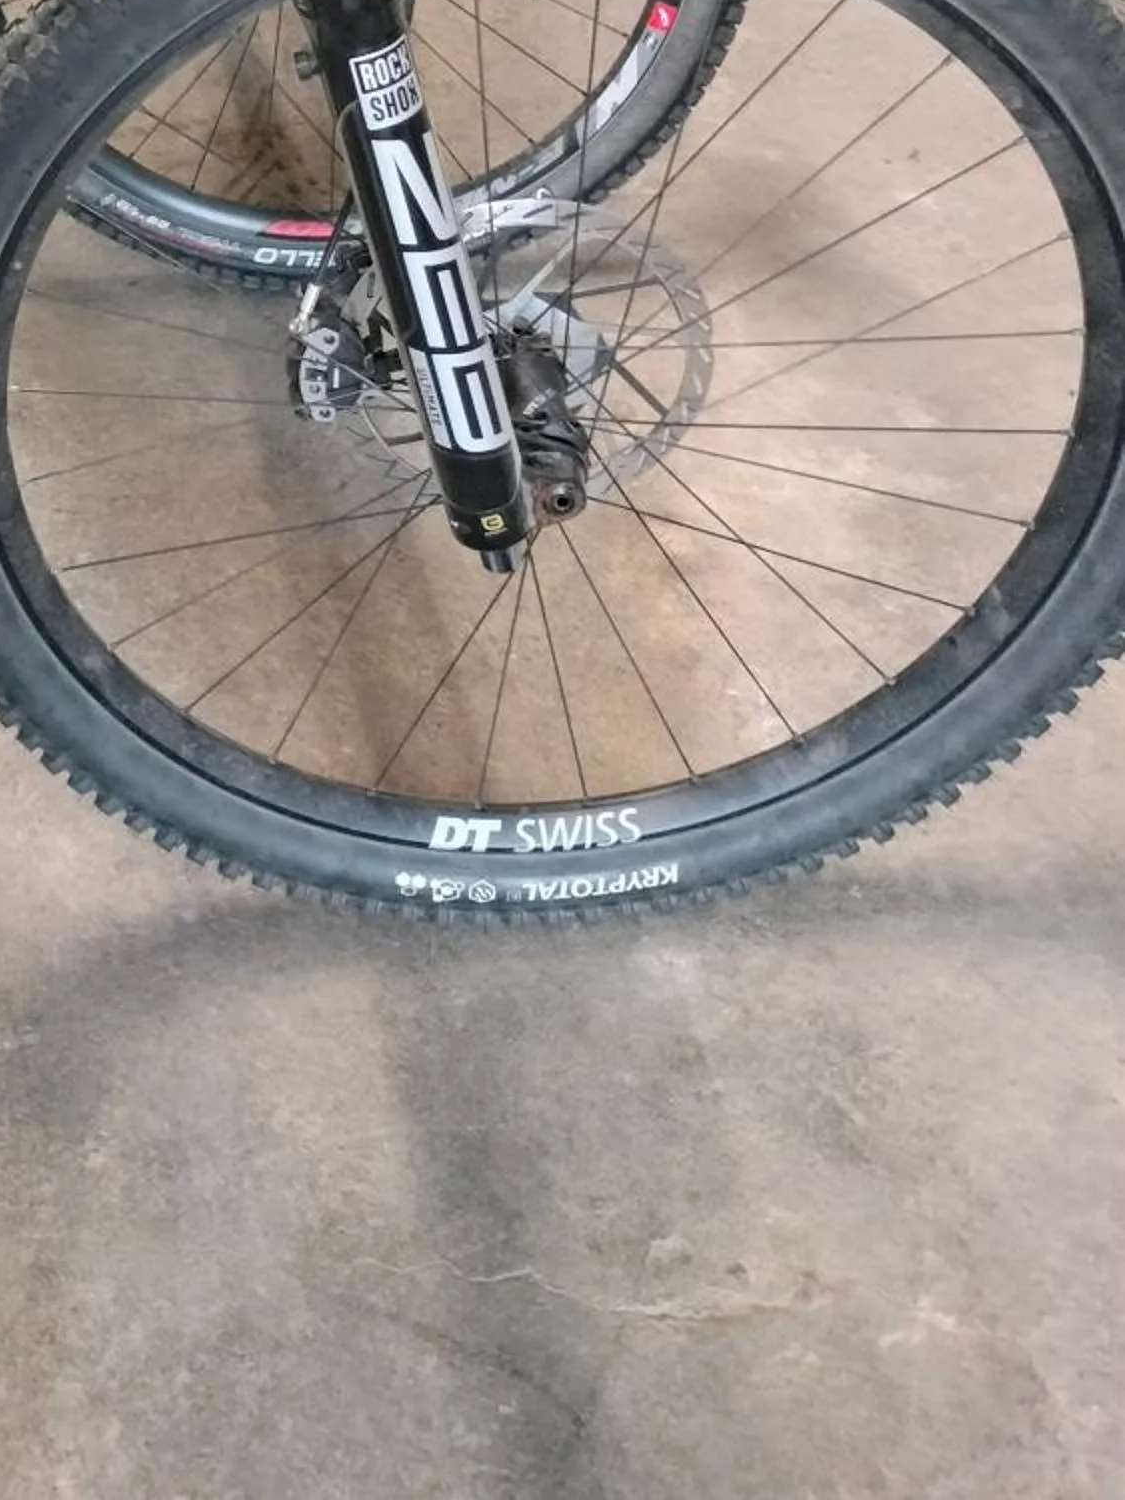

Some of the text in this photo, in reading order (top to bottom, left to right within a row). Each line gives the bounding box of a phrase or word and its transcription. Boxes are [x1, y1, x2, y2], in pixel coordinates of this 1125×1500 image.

[358, 43, 414, 92] ROCK
[370, 77, 420, 122] SHOX
[428, 807, 642, 852] DT SWISS
[523, 863, 679, 902] KRYPTOTAL
